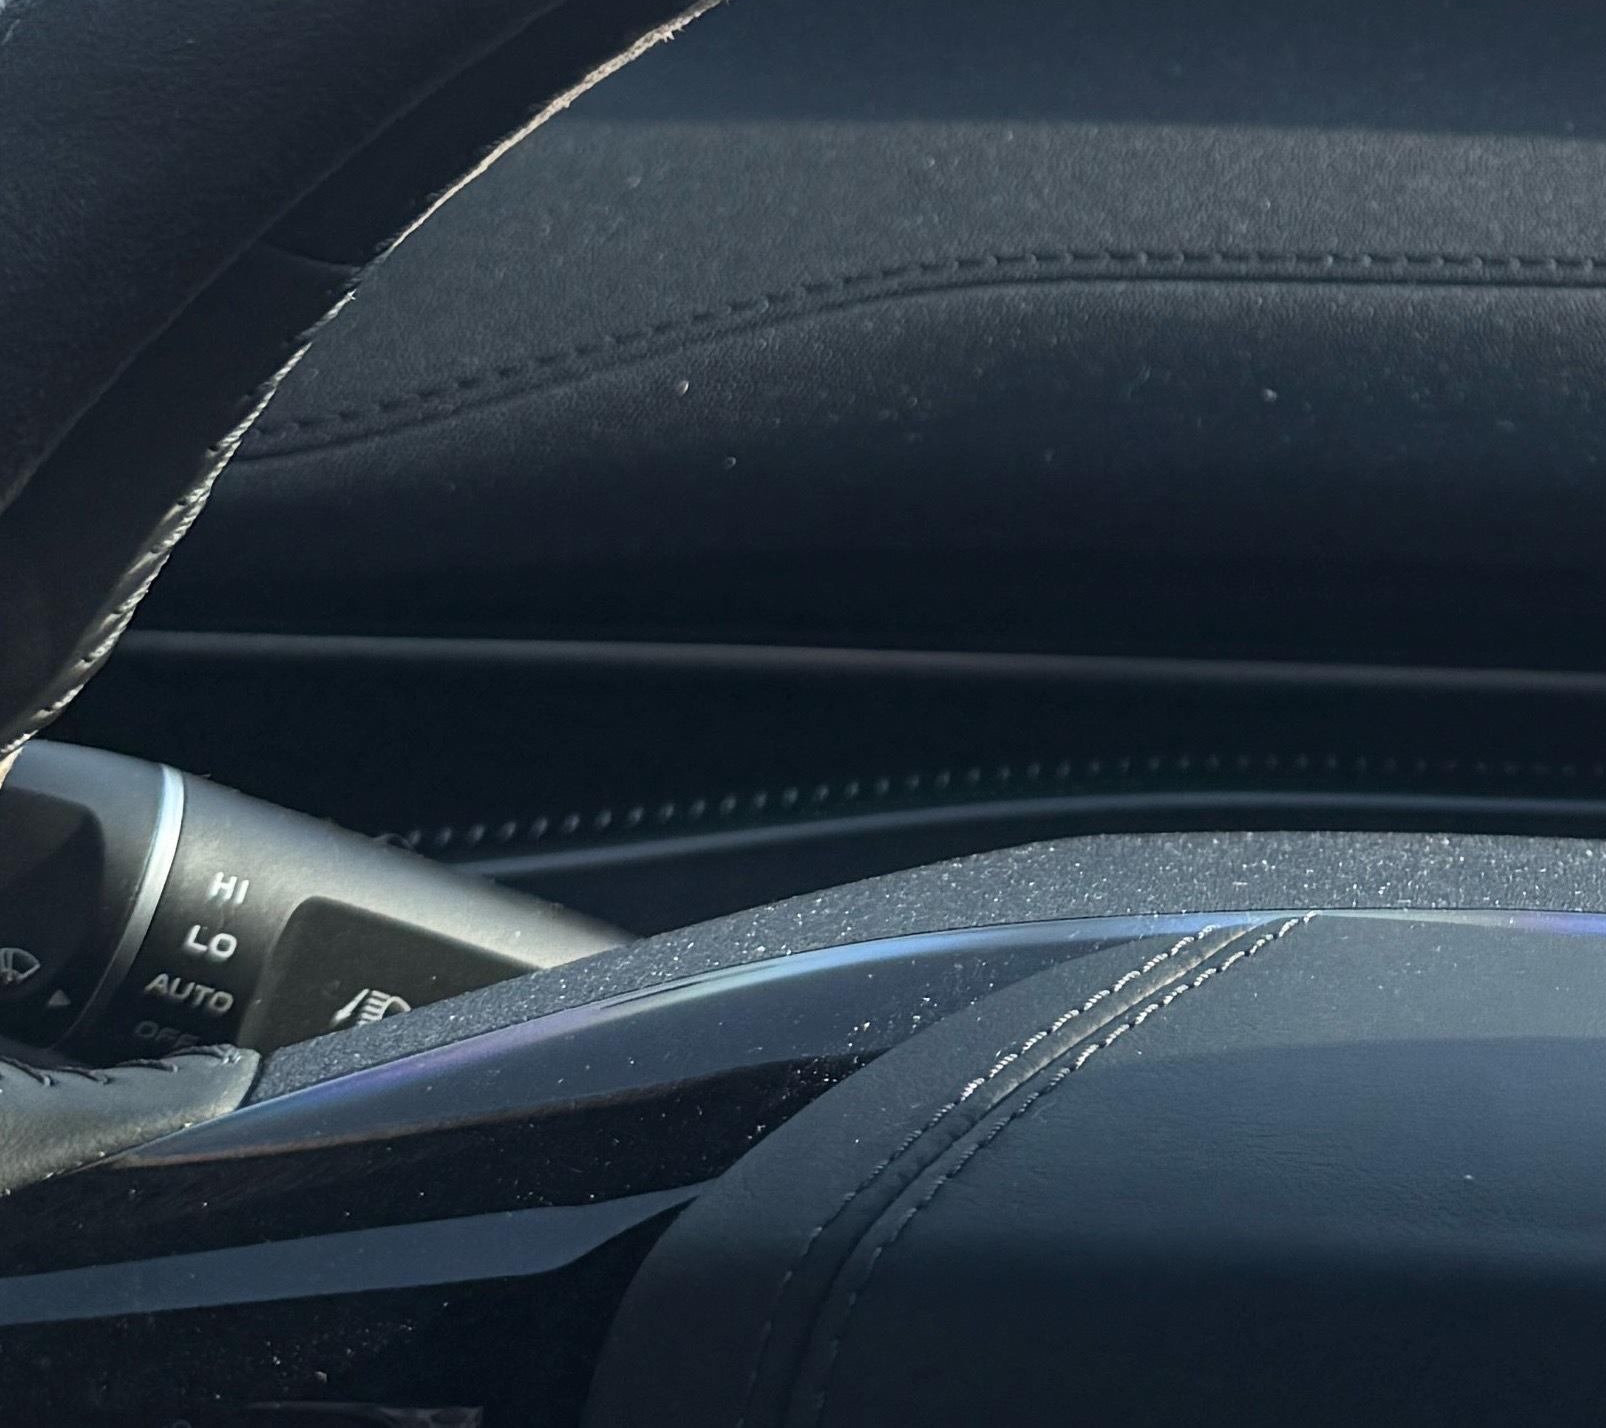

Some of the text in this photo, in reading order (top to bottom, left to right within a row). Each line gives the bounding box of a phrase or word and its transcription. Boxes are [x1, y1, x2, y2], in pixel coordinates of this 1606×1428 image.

[208, 871, 249, 905] HI
[184, 924, 238, 961] LO
[144, 973, 234, 1012] AUTO
[134, 1020, 199, 1047] OFF
